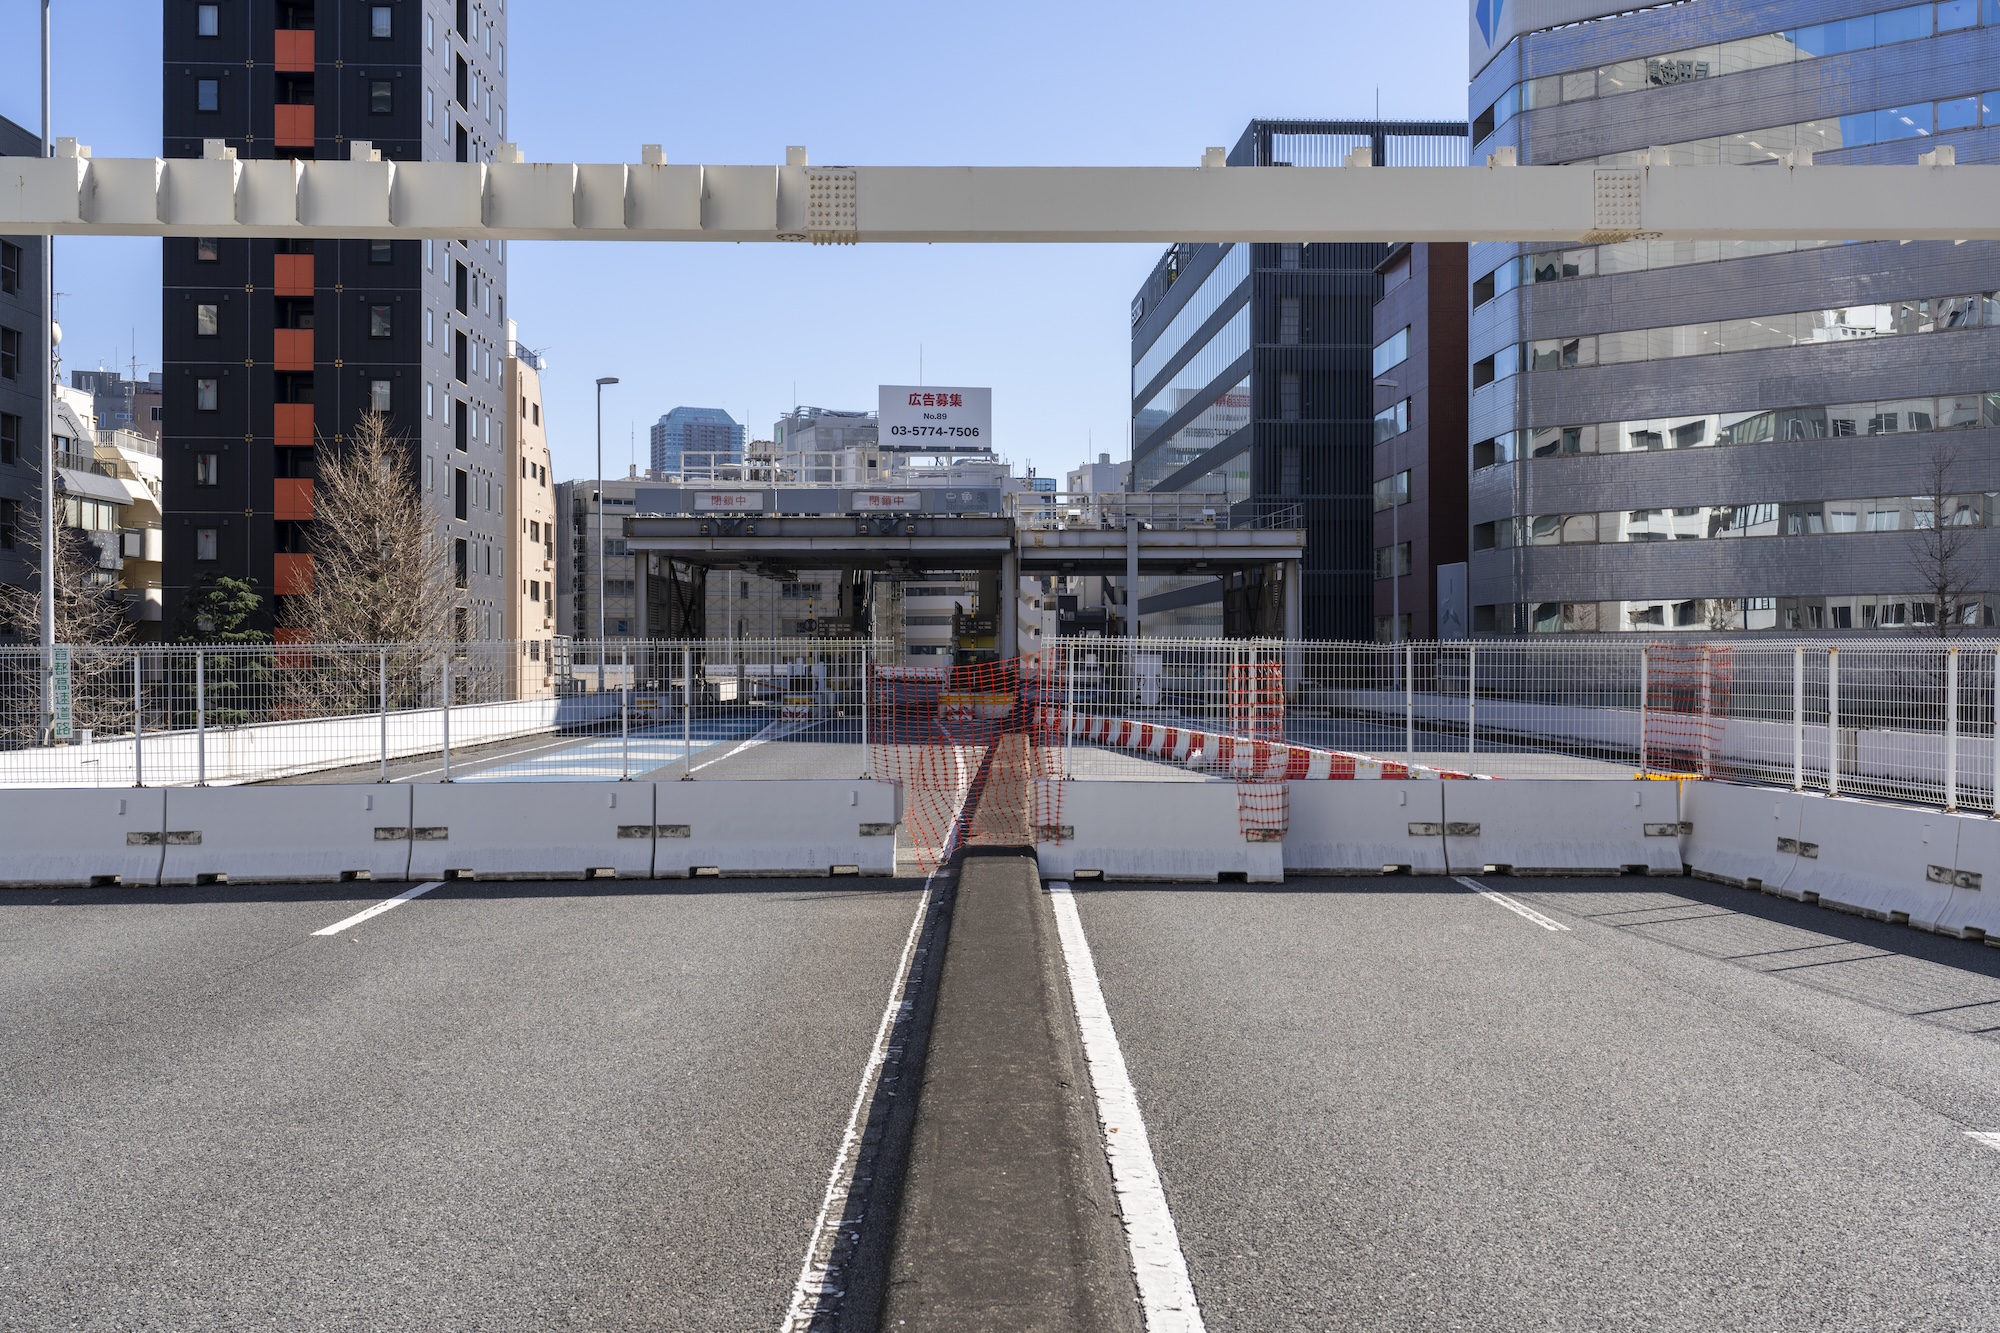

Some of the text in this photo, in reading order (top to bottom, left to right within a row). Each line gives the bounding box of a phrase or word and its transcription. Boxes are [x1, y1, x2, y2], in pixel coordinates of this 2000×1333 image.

[909, 393, 962, 407] 広告募集
[891, 426, 980, 437] 03-5774-7506
[711, 495, 746, 506] 閉鎖中
[869, 495, 904, 506] 閉鎖中
[53, 647, 71, 736] 首都高速道路
